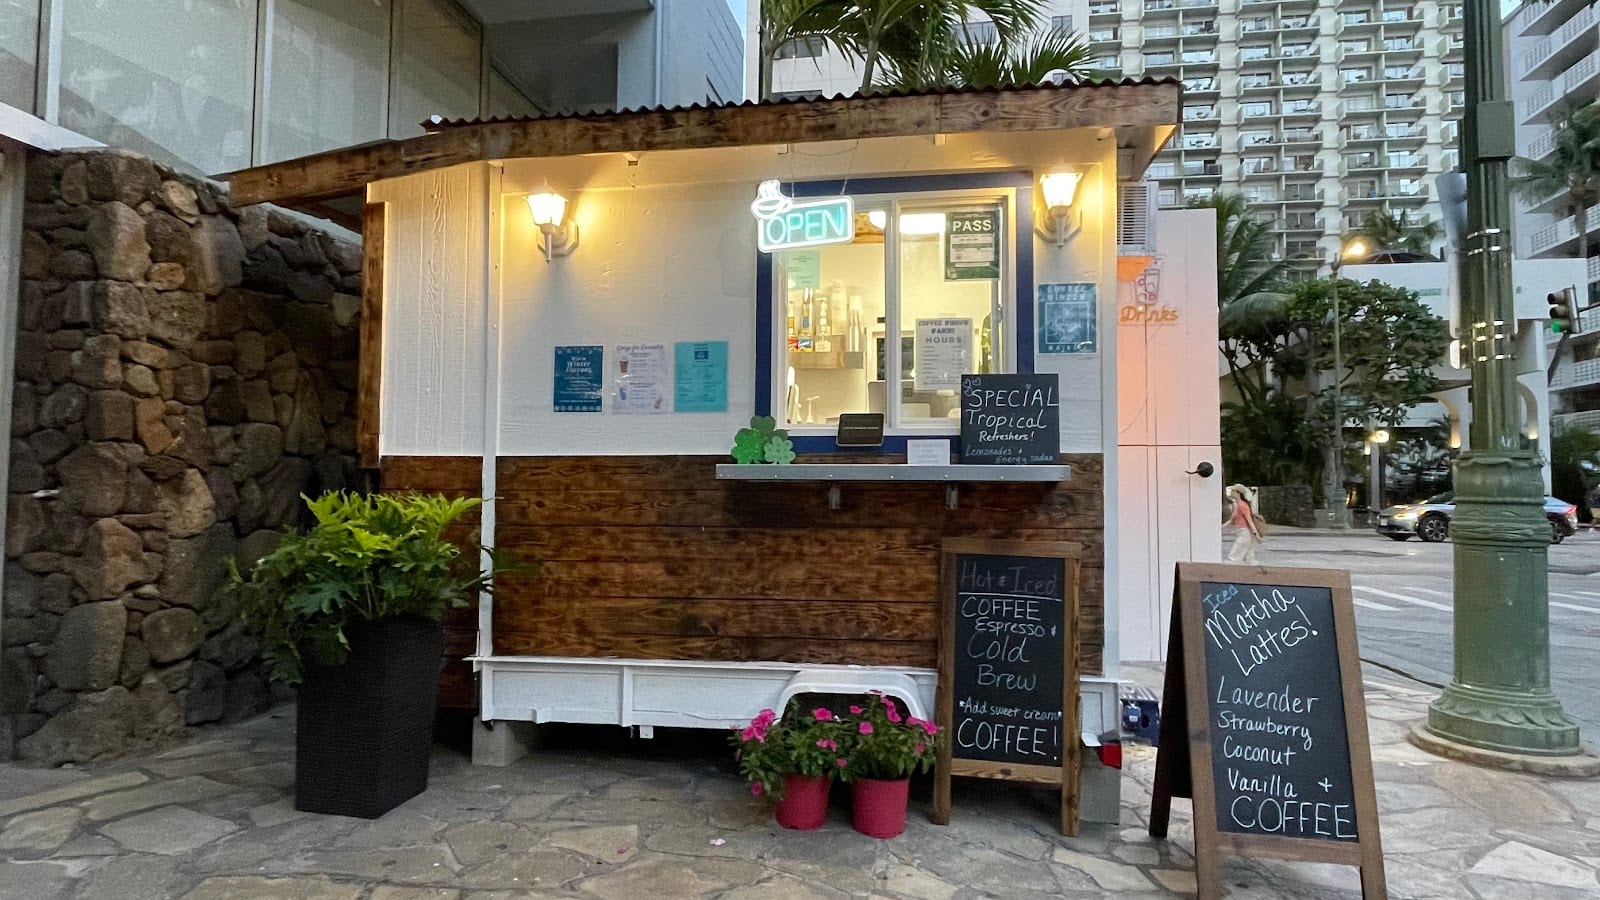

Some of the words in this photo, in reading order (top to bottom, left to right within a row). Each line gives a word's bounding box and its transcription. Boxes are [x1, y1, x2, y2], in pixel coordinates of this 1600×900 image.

[766, 206, 844, 244] OPEN
[953, 219, 992, 232] PASS
[1120, 305, 1179, 323] Drinks
[925, 336, 962, 344] HOURS
[966, 408, 1047, 434] Tropical
[960, 560, 993, 589] Hot
[1008, 566, 1058, 595] Iced
[961, 596, 1042, 621] COFFEE
[1203, 584, 1239, 613] Iced
[975, 616, 1046, 637] Espresso
[1204, 588, 1296, 650] Matcha
[967, 630, 1030, 663] Cold
[1231, 604, 1318, 677] Lattes!
[977, 663, 1037, 691] Brew
[1216, 675, 1319, 714] Lavender
[990, 705, 1020, 718] sweet
[1217, 710, 1313, 750] Strawberry
[1223, 735, 1296, 766] Coconut
[1228, 767, 1298, 798] Vanilla
[1231, 795, 1358, 838] COFFEE
